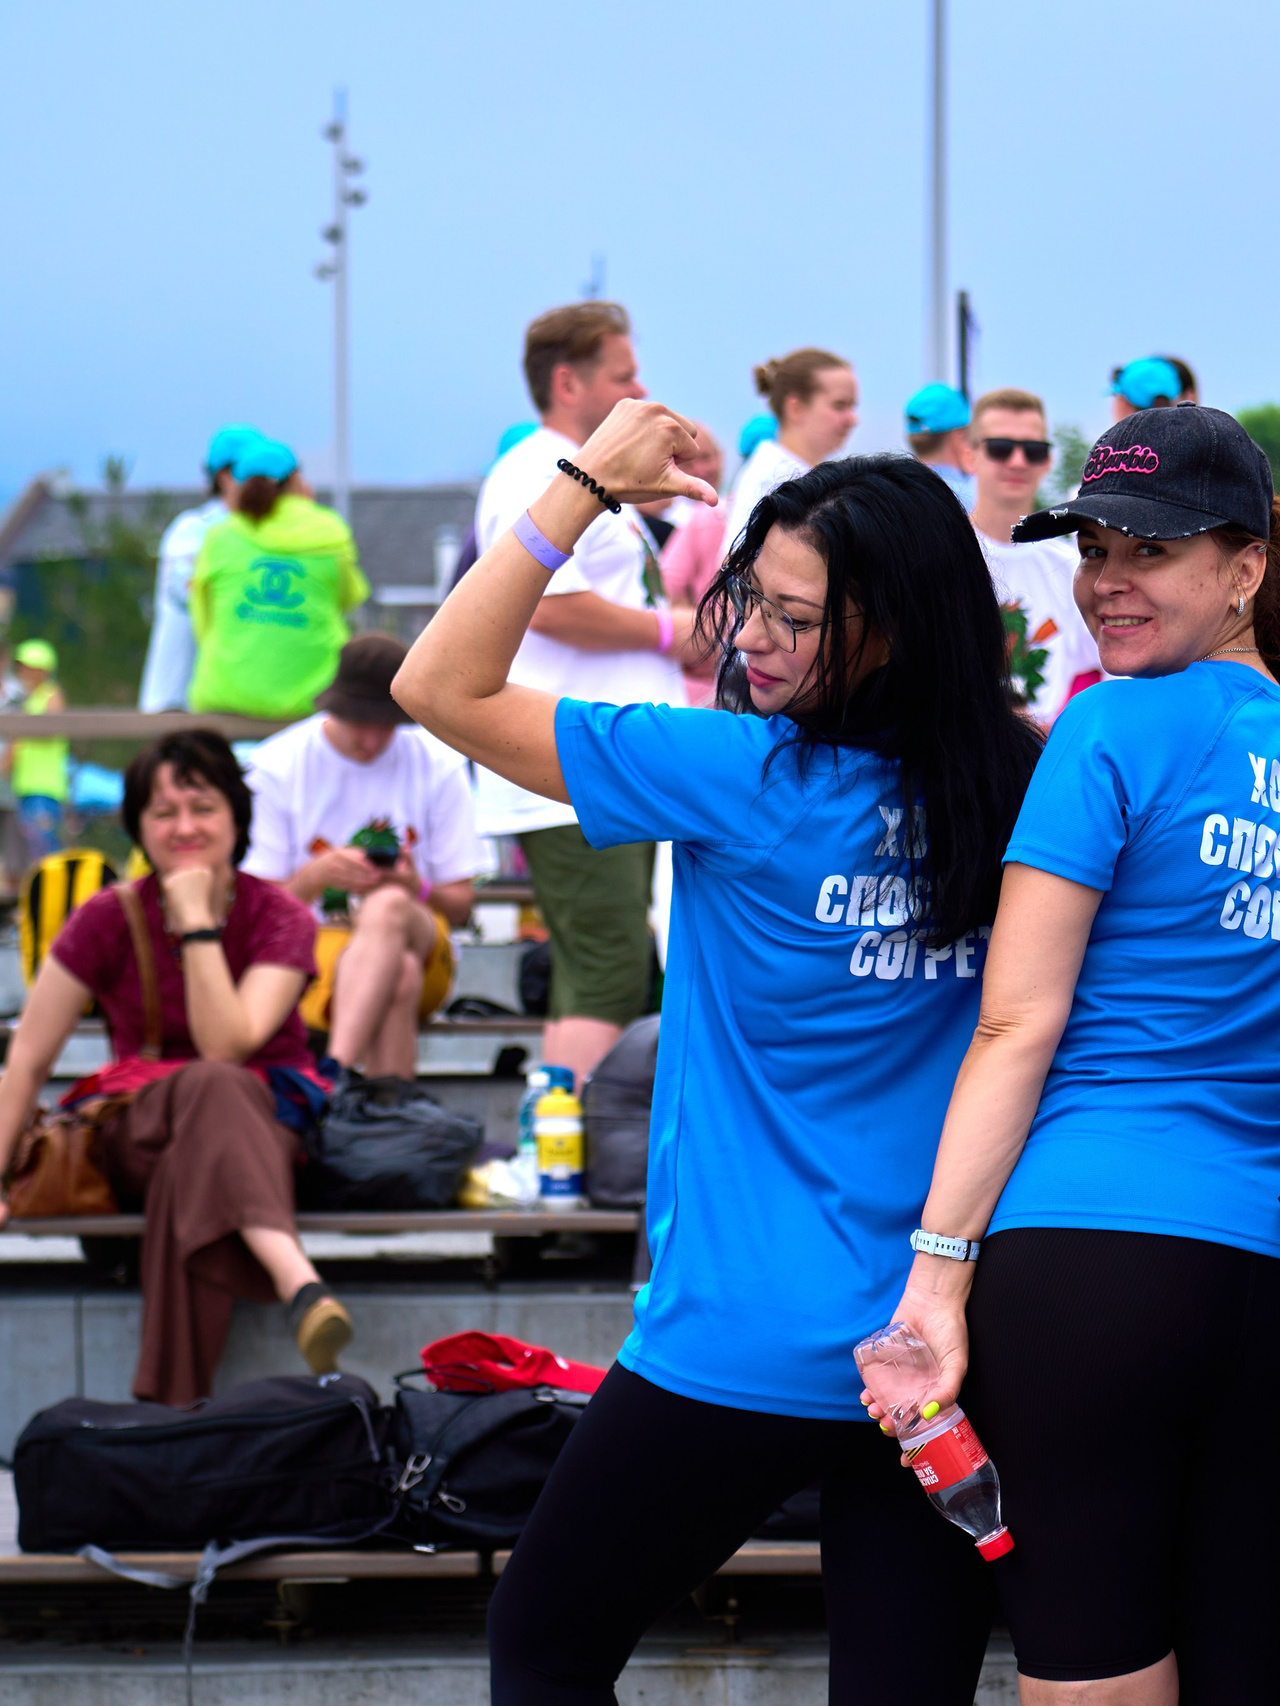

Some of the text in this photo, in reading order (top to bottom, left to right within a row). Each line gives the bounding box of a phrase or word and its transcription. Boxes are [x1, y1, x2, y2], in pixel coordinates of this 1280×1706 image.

[1083, 445, 1159, 482] Barbie
[874, 805, 928, 859] ХО
[815, 875, 932, 927] СПОС
